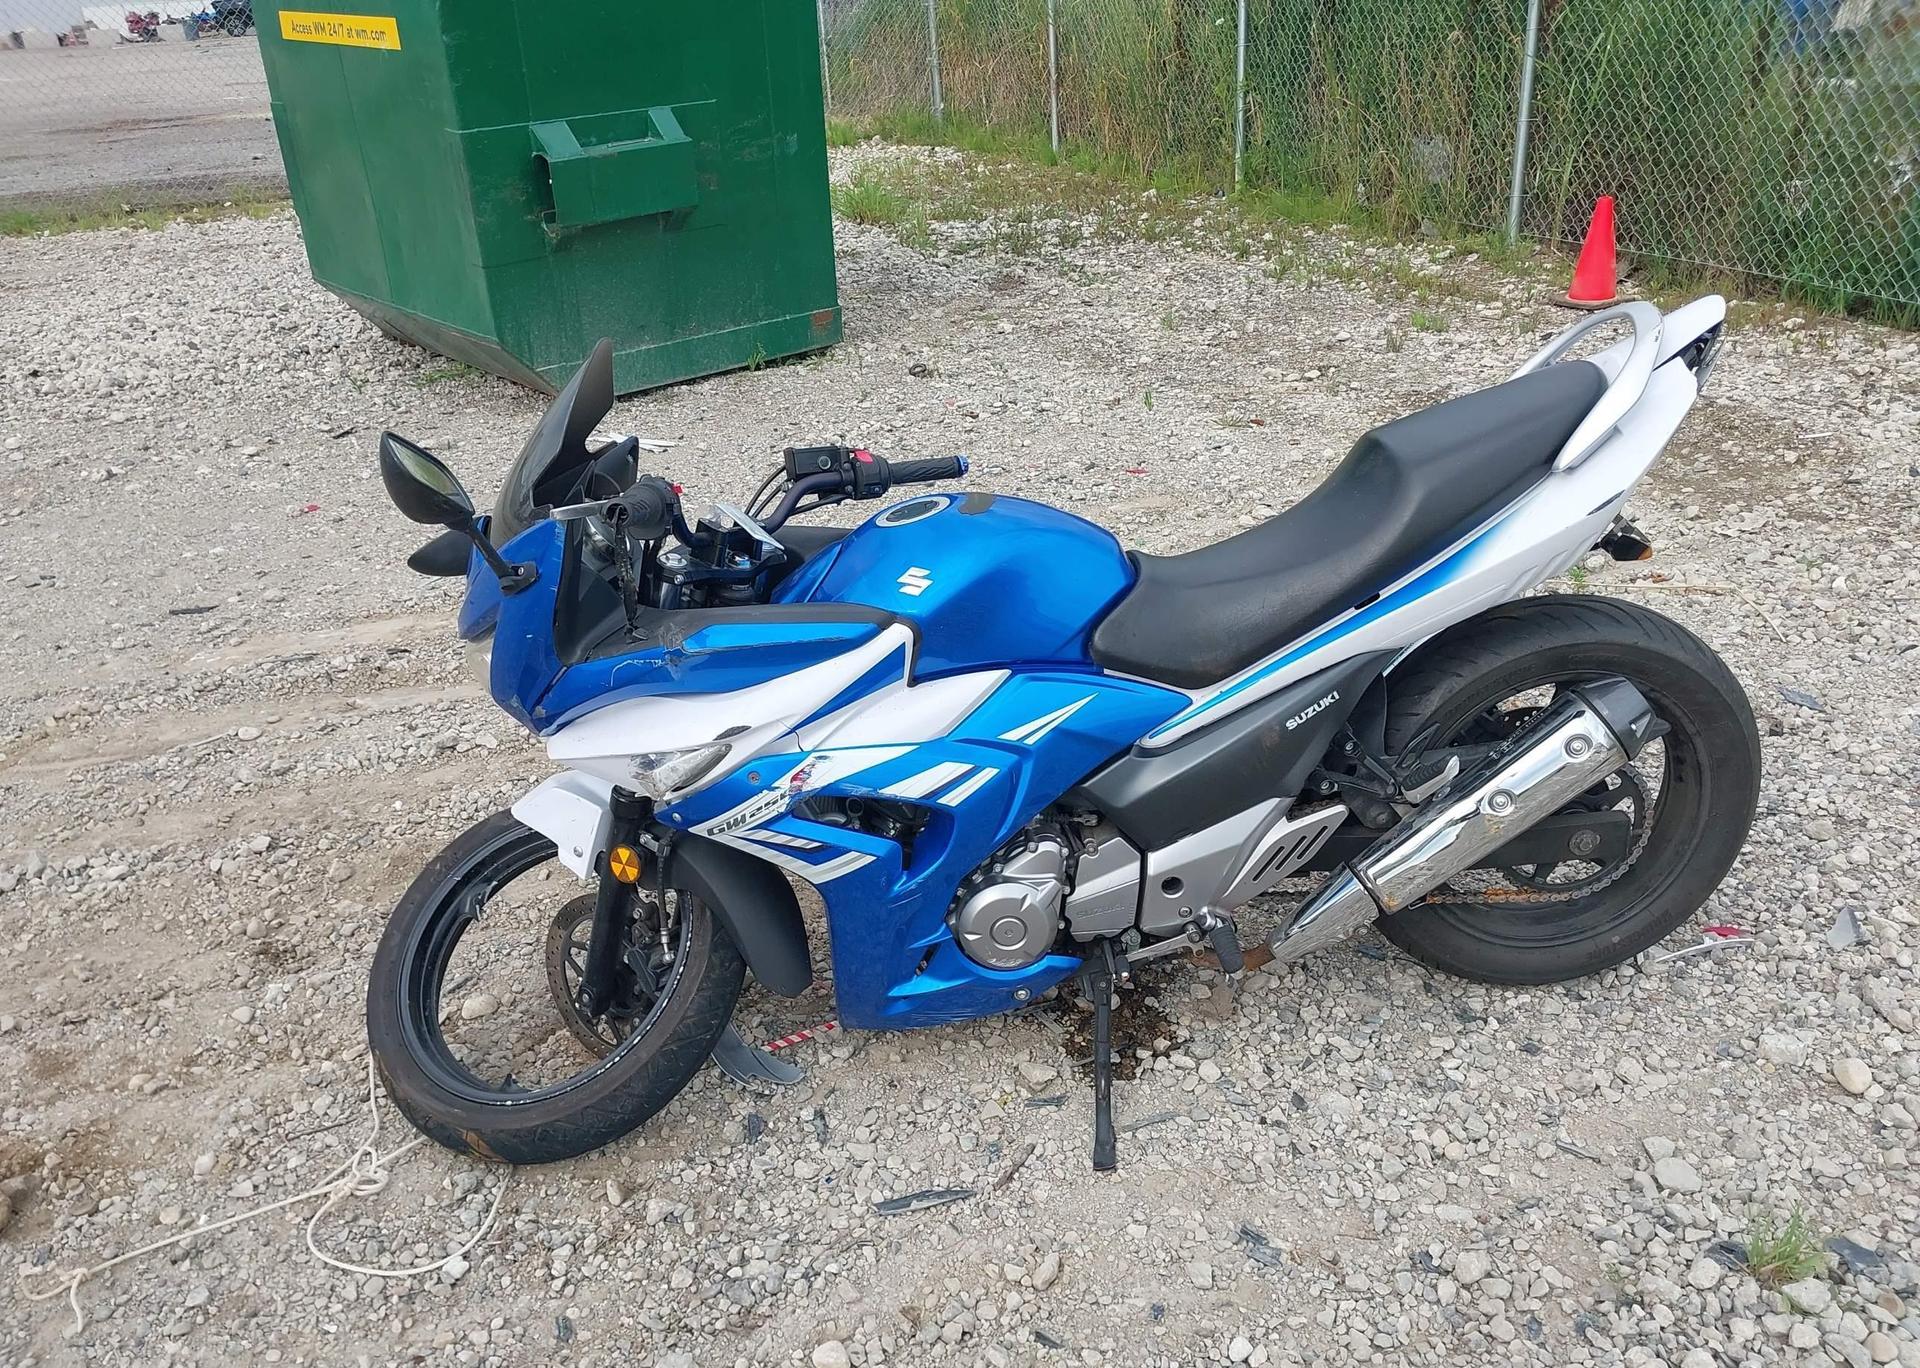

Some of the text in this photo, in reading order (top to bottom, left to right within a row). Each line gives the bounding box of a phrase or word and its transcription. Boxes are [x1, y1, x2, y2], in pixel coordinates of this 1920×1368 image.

[291, 20, 386, 42] Access WM 24/7 at wm.com
[1285, 690, 1340, 730] SUZUKI
